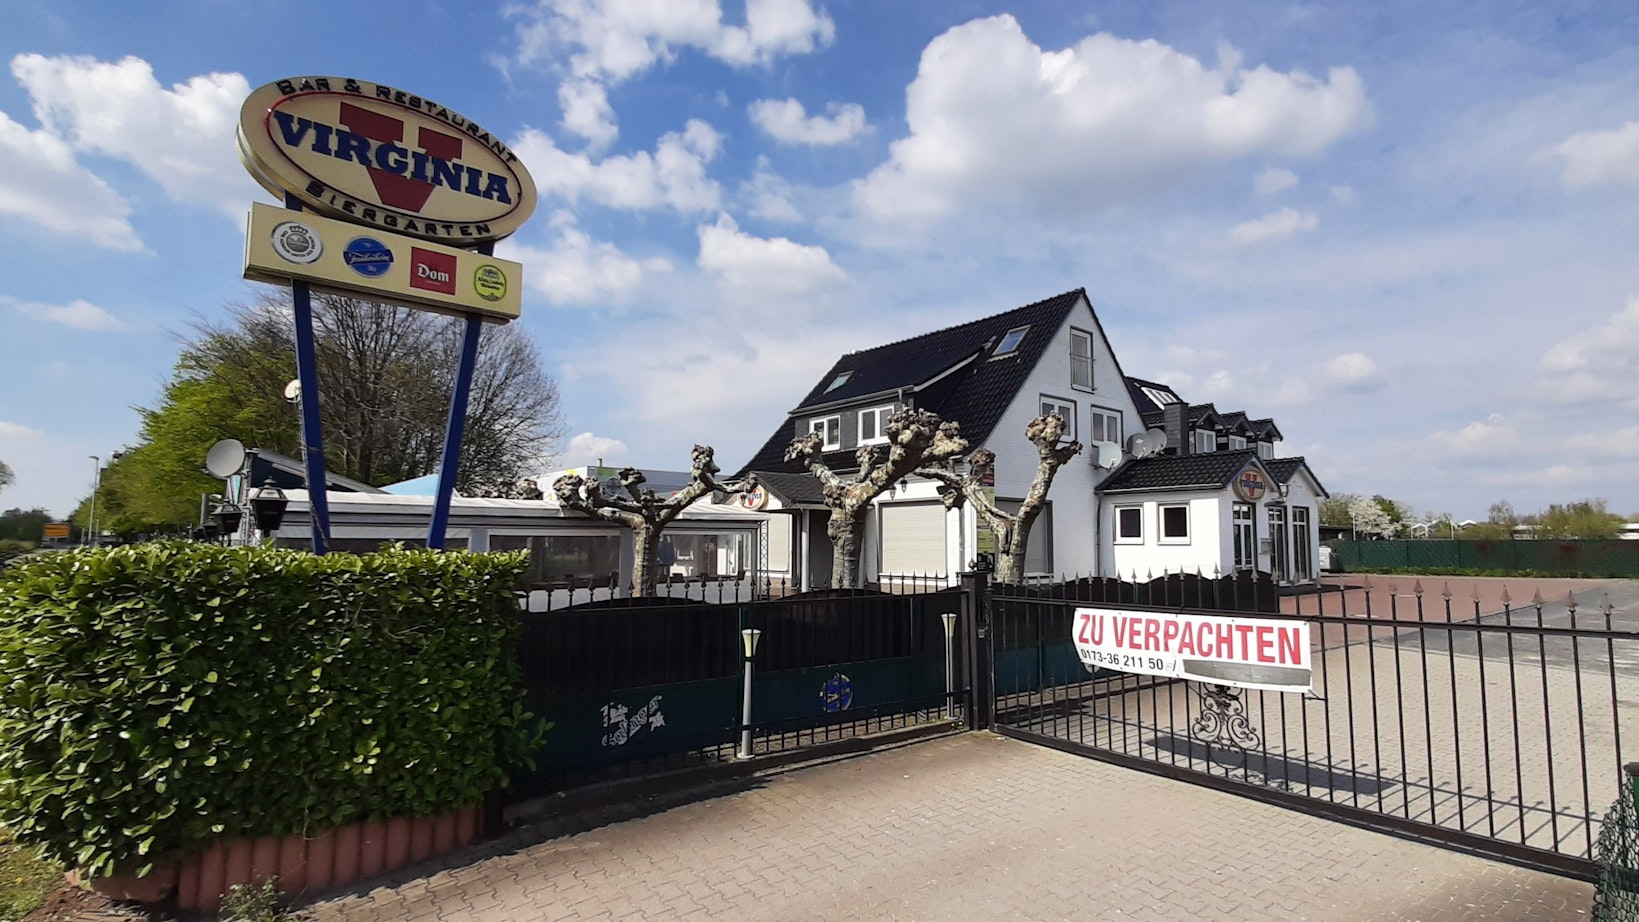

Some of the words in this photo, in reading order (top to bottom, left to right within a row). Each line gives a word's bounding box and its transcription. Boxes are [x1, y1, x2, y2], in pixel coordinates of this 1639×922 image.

[276, 78, 330, 96] BAR
[344, 78, 362, 94] &
[376, 84, 518, 163] RESTAURANT
[274, 111, 511, 205] VIRGINIA
[305, 180, 492, 236] BIERGARTEN
[417, 263, 448, 282] Dom
[1078, 613, 1104, 646] ZU
[1113, 615, 1300, 664] VERPACHTEN
[1080, 648, 1120, 665] 0173-36
[1123, 654, 1143, 668] 211
[1148, 657, 1164, 671] 50
